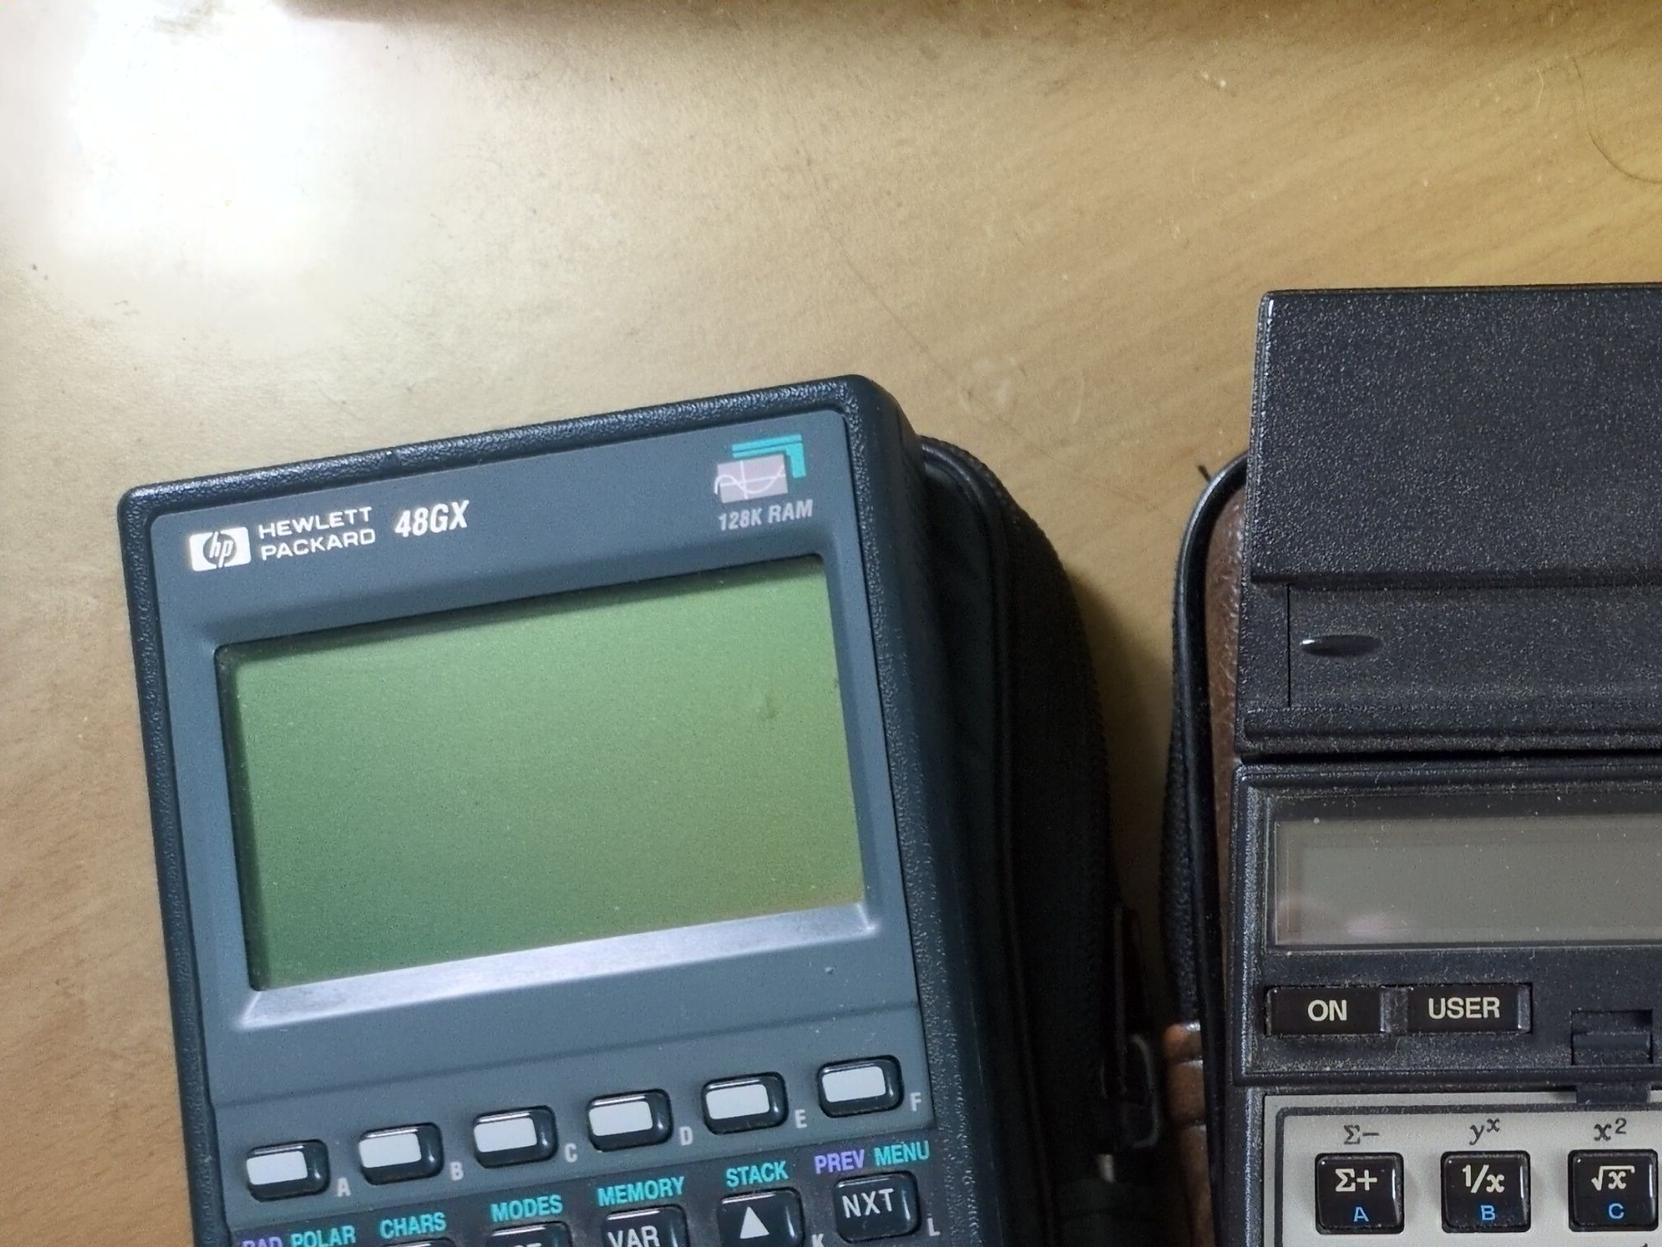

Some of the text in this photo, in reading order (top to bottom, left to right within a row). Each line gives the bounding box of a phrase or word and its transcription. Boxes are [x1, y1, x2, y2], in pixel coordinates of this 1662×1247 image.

[258, 508, 372, 539] HEWLETT
[394, 501, 469, 538] 48GX
[718, 501, 812, 531] 128K RAM
[261, 529, 376, 560] PACKARD
[1307, 1000, 1347, 1022] ON
[1428, 997, 1500, 1020] USER
[815, 1141, 929, 1174] PREV MENU
[726, 1161, 788, 1188] STACK
[598, 1176, 684, 1206] MEMORY
[842, 1188, 893, 1218] NXT
[491, 1195, 563, 1222] MODES
[380, 1213, 446, 1238] CHARS
